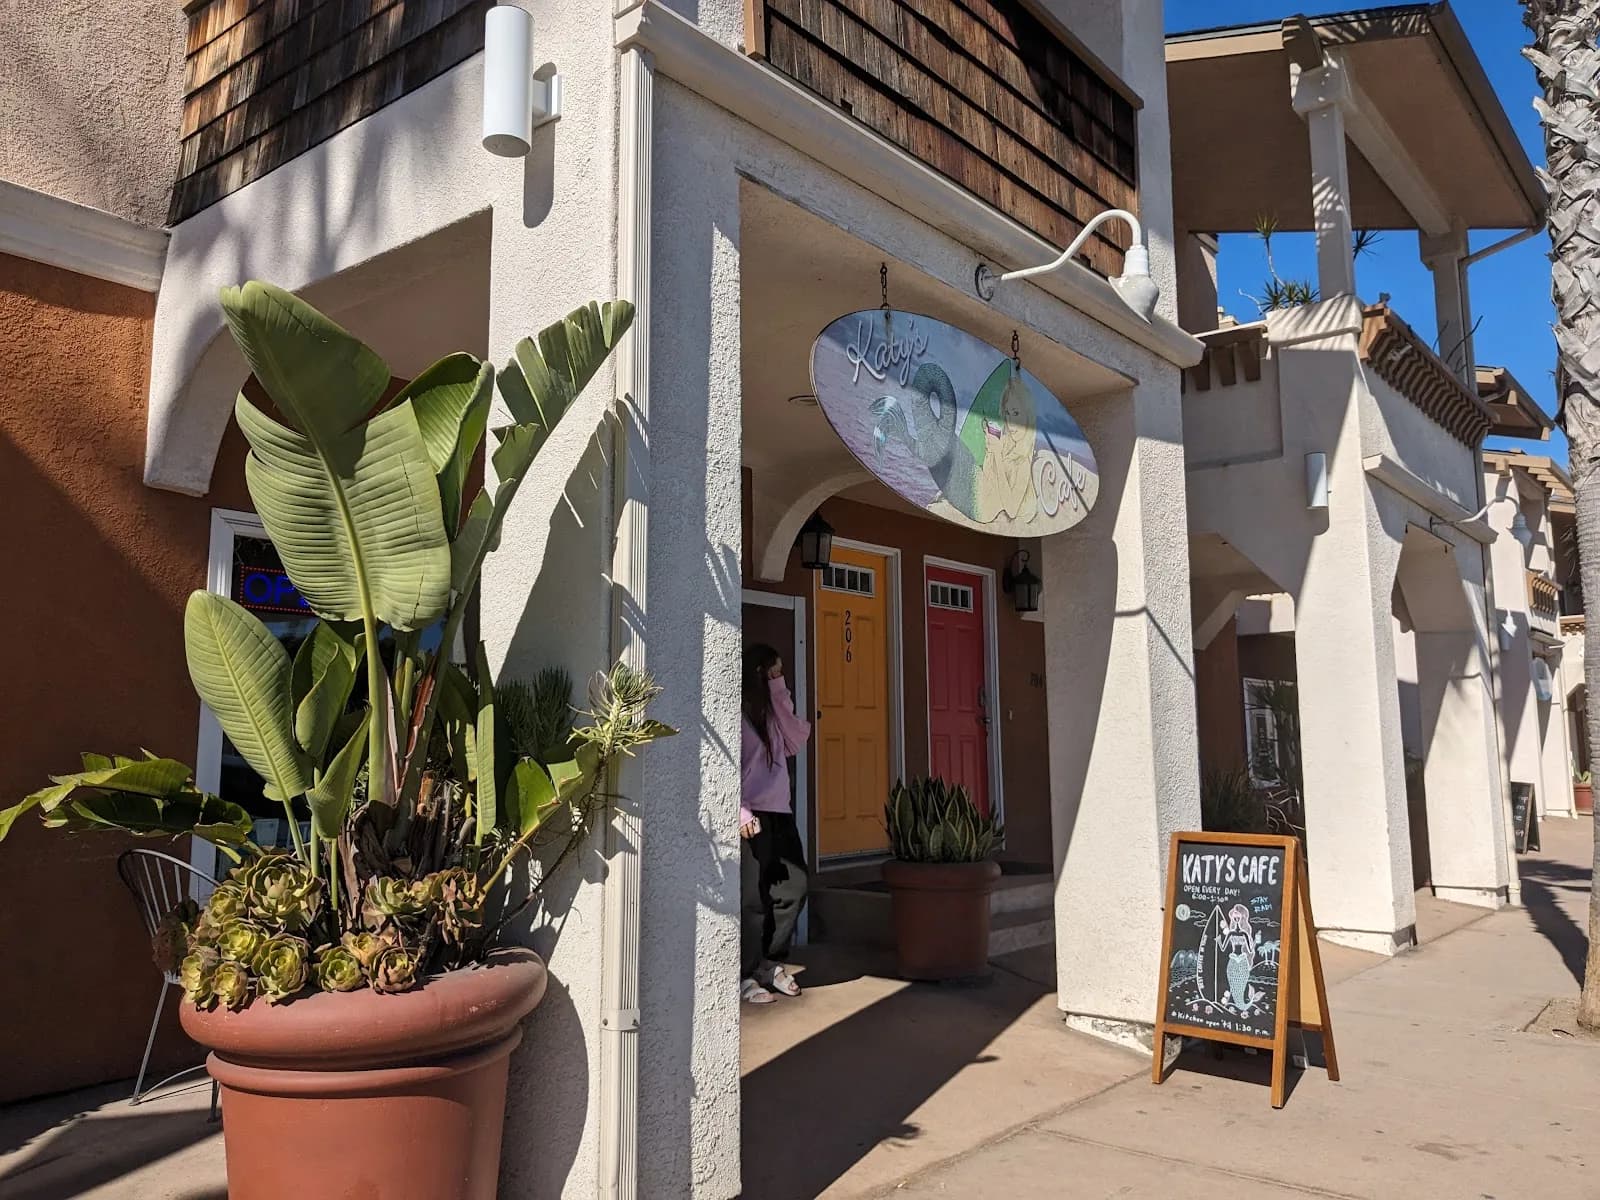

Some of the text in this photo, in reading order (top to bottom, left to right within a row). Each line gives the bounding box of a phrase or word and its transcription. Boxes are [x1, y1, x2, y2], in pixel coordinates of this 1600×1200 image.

[846, 313, 929, 386] Katy's
[1040, 452, 1086, 516] Cafe
[244, 572, 310, 608] OP
[1182, 853, 1280, 885] KATY'S CAFE
[1183, 885, 1240, 897] OPEN EVERY DAY!
[1177, 1011, 1204, 1023] Kitchen
[1205, 1020, 1220, 1028] open
[1235, 1022, 1252, 1032] 1:30
